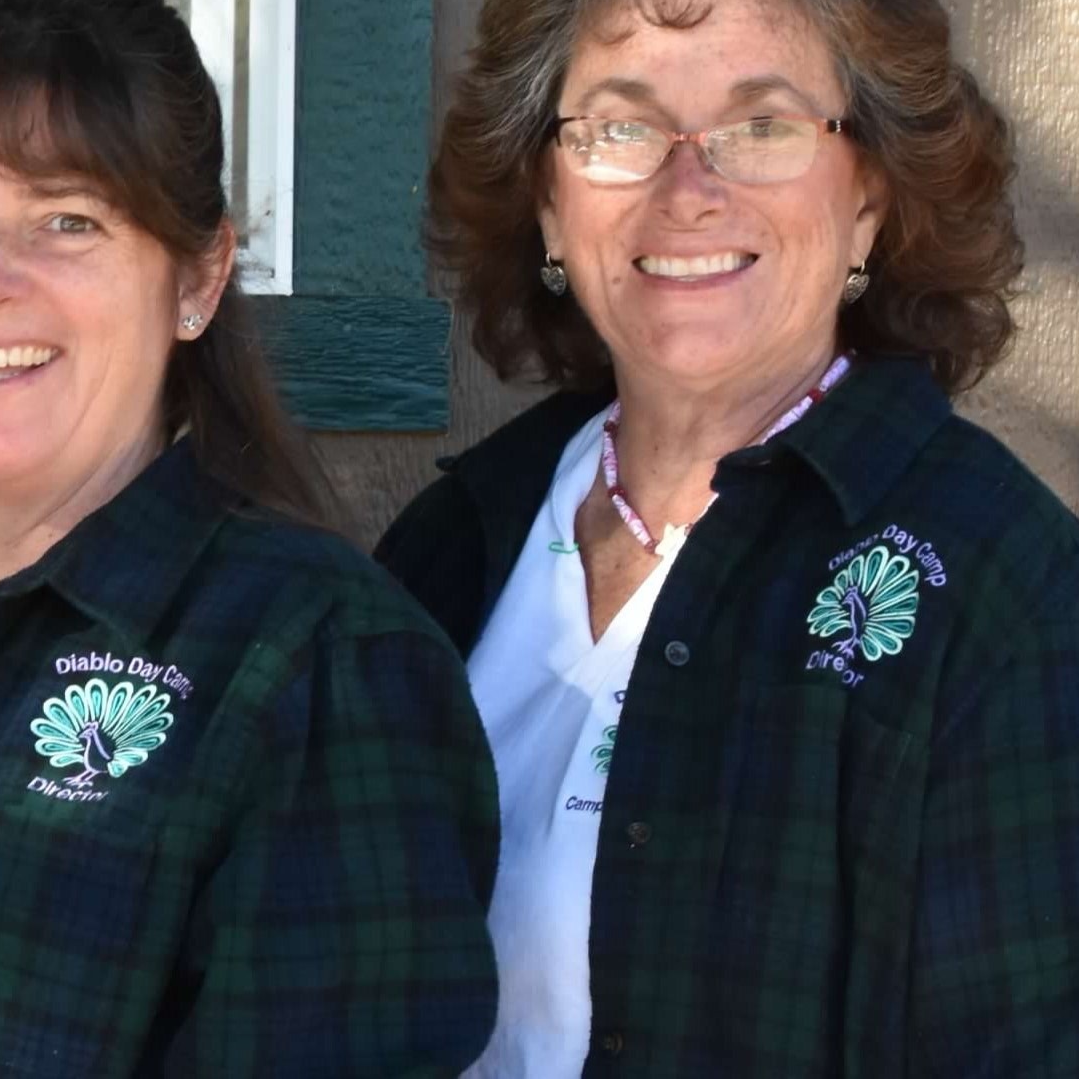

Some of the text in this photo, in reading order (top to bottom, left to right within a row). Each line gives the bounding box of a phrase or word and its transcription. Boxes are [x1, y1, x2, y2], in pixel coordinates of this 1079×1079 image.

[881, 523, 920, 554] Day
[915, 542, 948, 587] Camp
[55, 651, 125, 675] Diablo
[127, 655, 164, 683] Day
[805, 649, 865, 689] Direor
